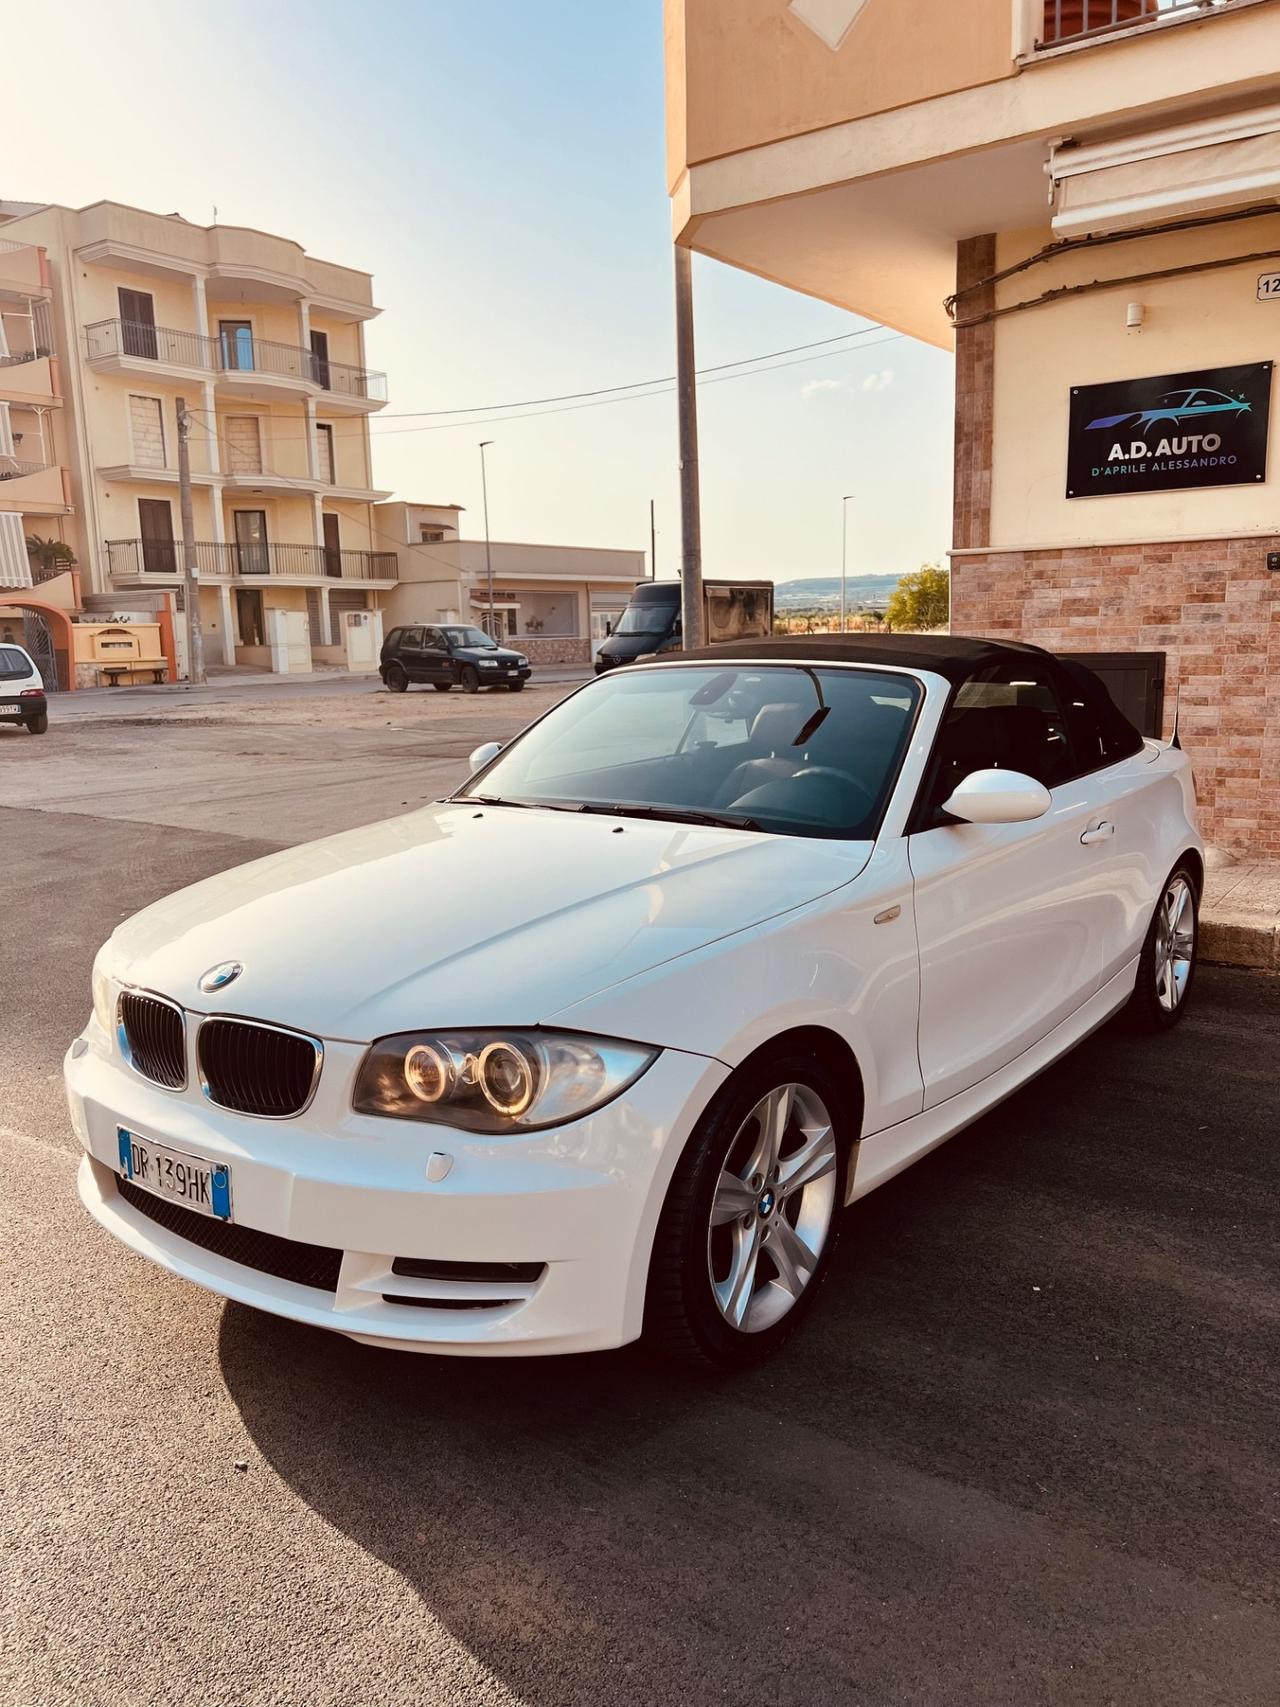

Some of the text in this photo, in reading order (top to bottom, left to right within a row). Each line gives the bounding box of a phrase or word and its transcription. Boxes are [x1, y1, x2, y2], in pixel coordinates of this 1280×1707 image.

[1108, 433, 1221, 461] A.D. AUTO
[1091, 455, 1237, 476] D'APRILE ALESSANDRO
